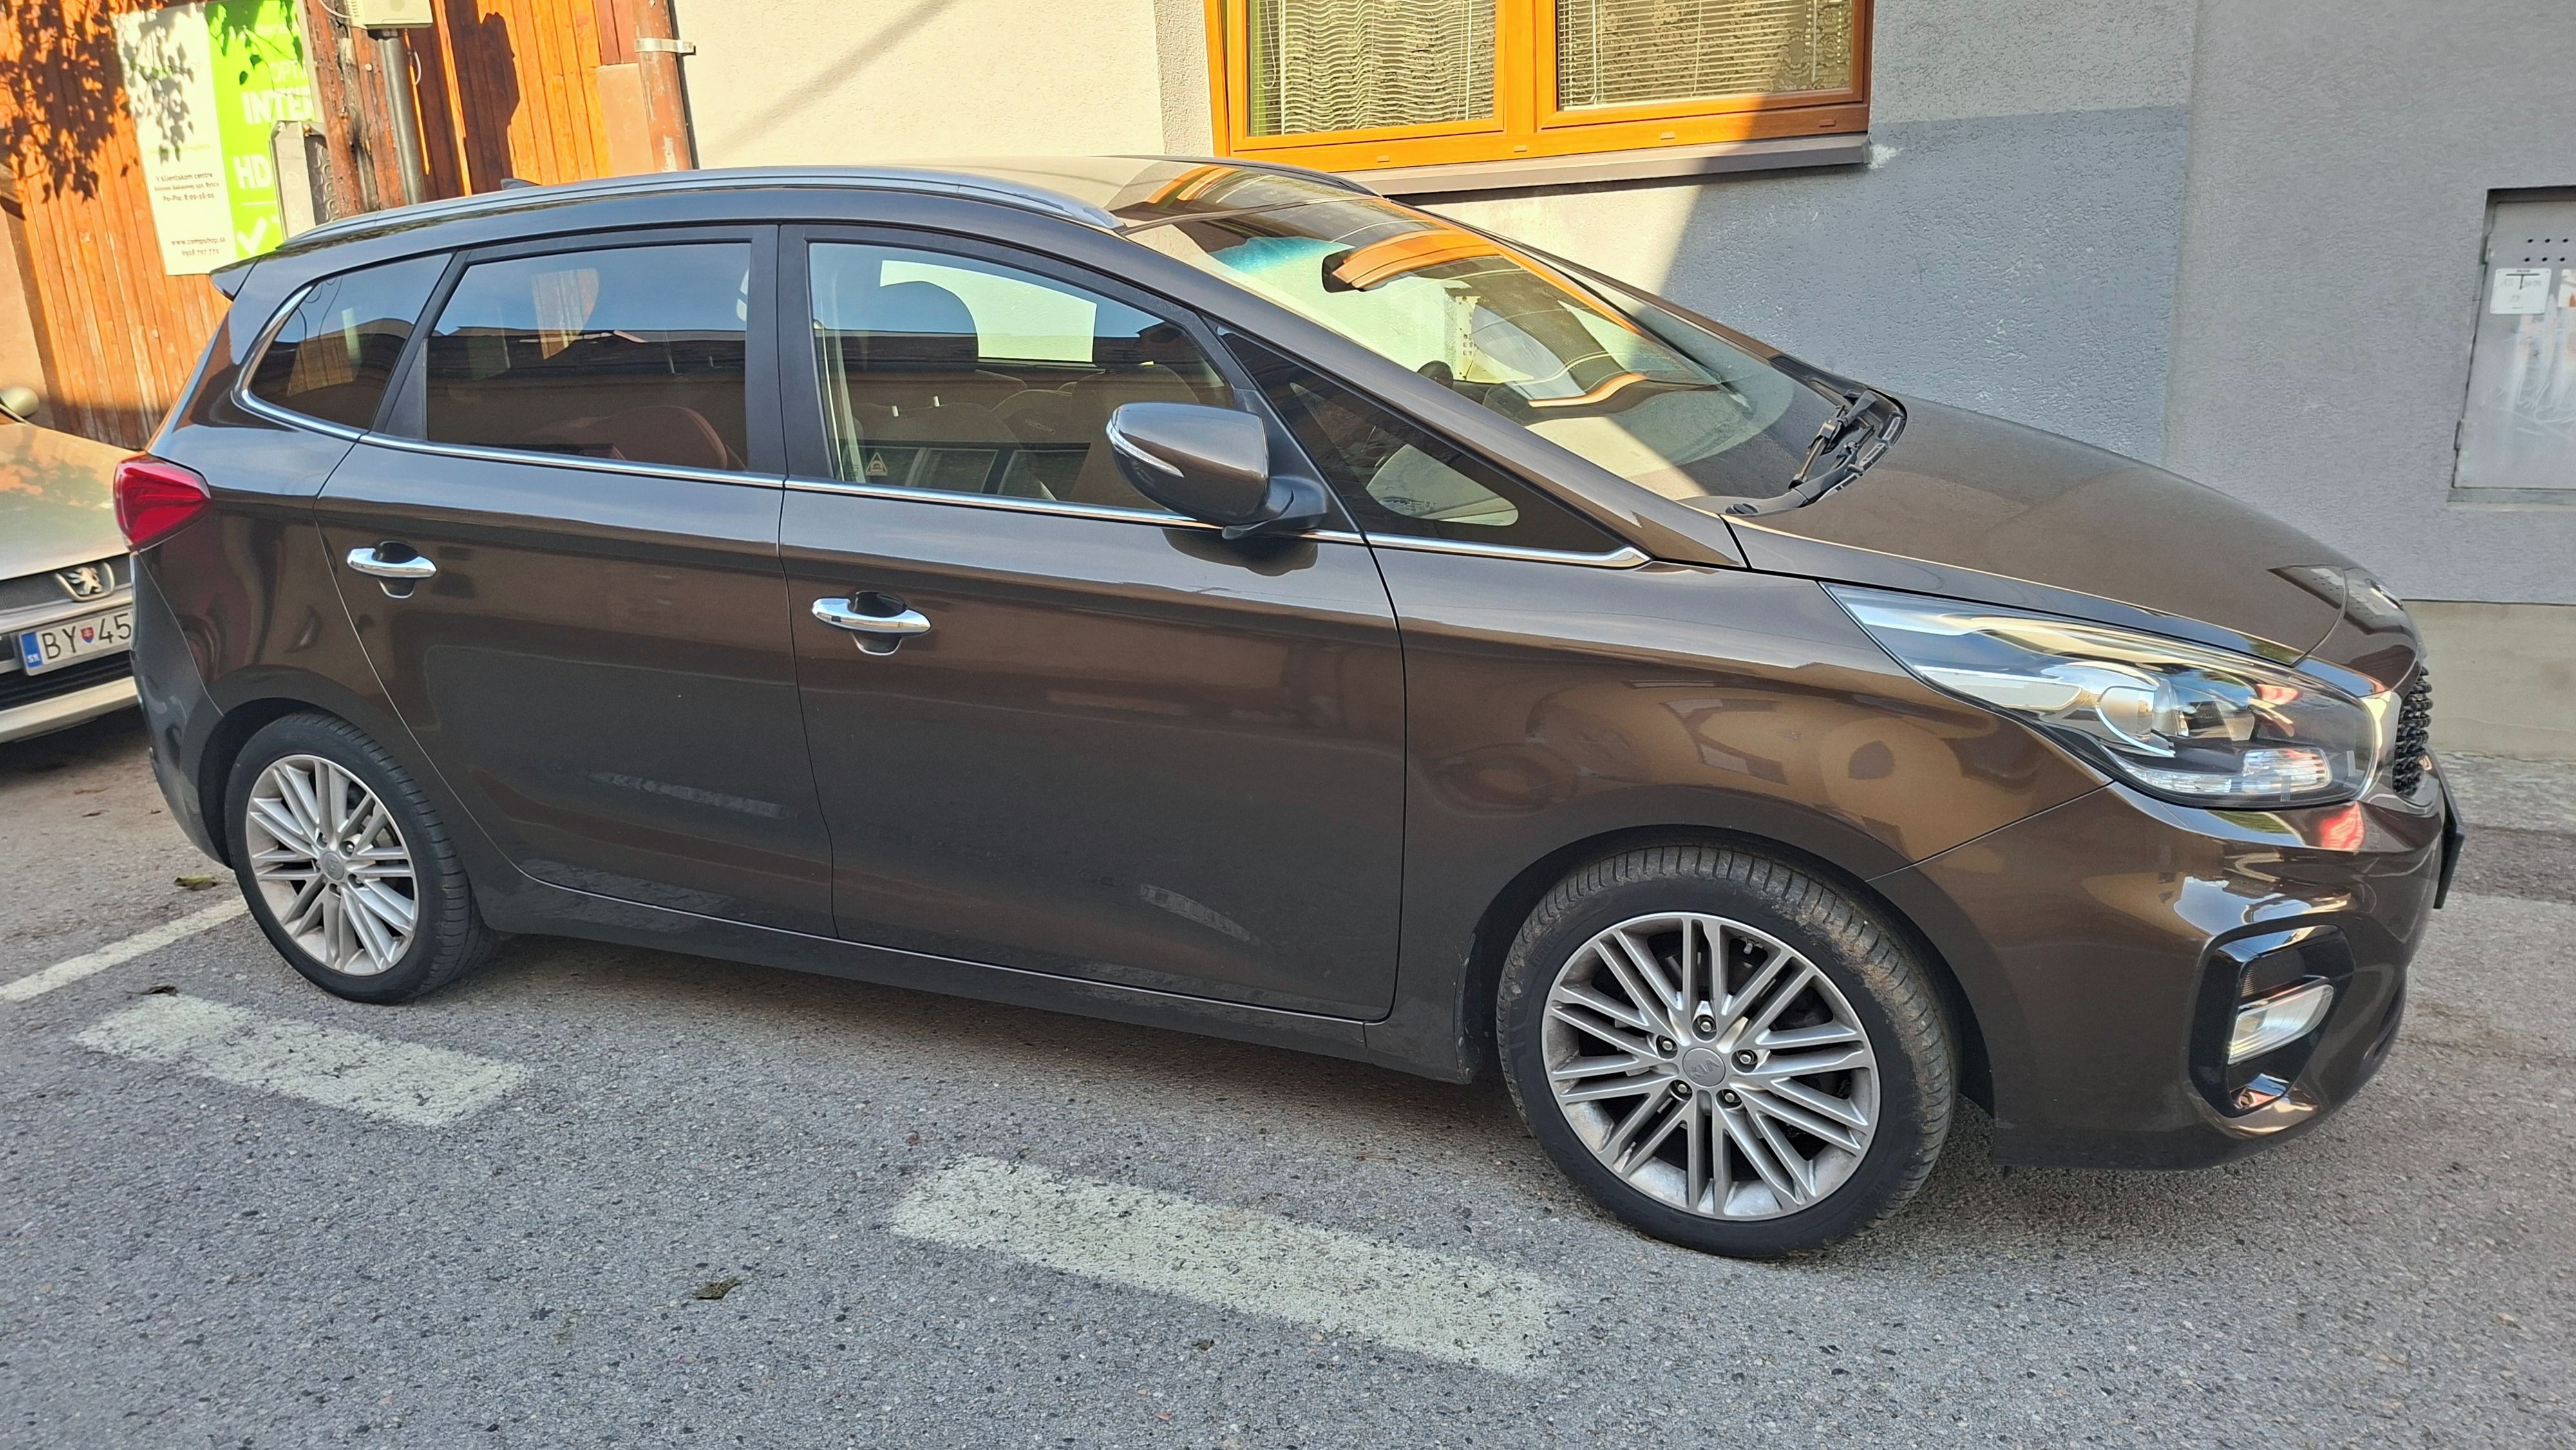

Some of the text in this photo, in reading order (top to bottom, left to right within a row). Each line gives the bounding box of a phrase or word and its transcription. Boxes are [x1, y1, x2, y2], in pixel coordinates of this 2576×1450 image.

[233, 155, 272, 189] HD
[41, 612, 132, 661] BY 45
